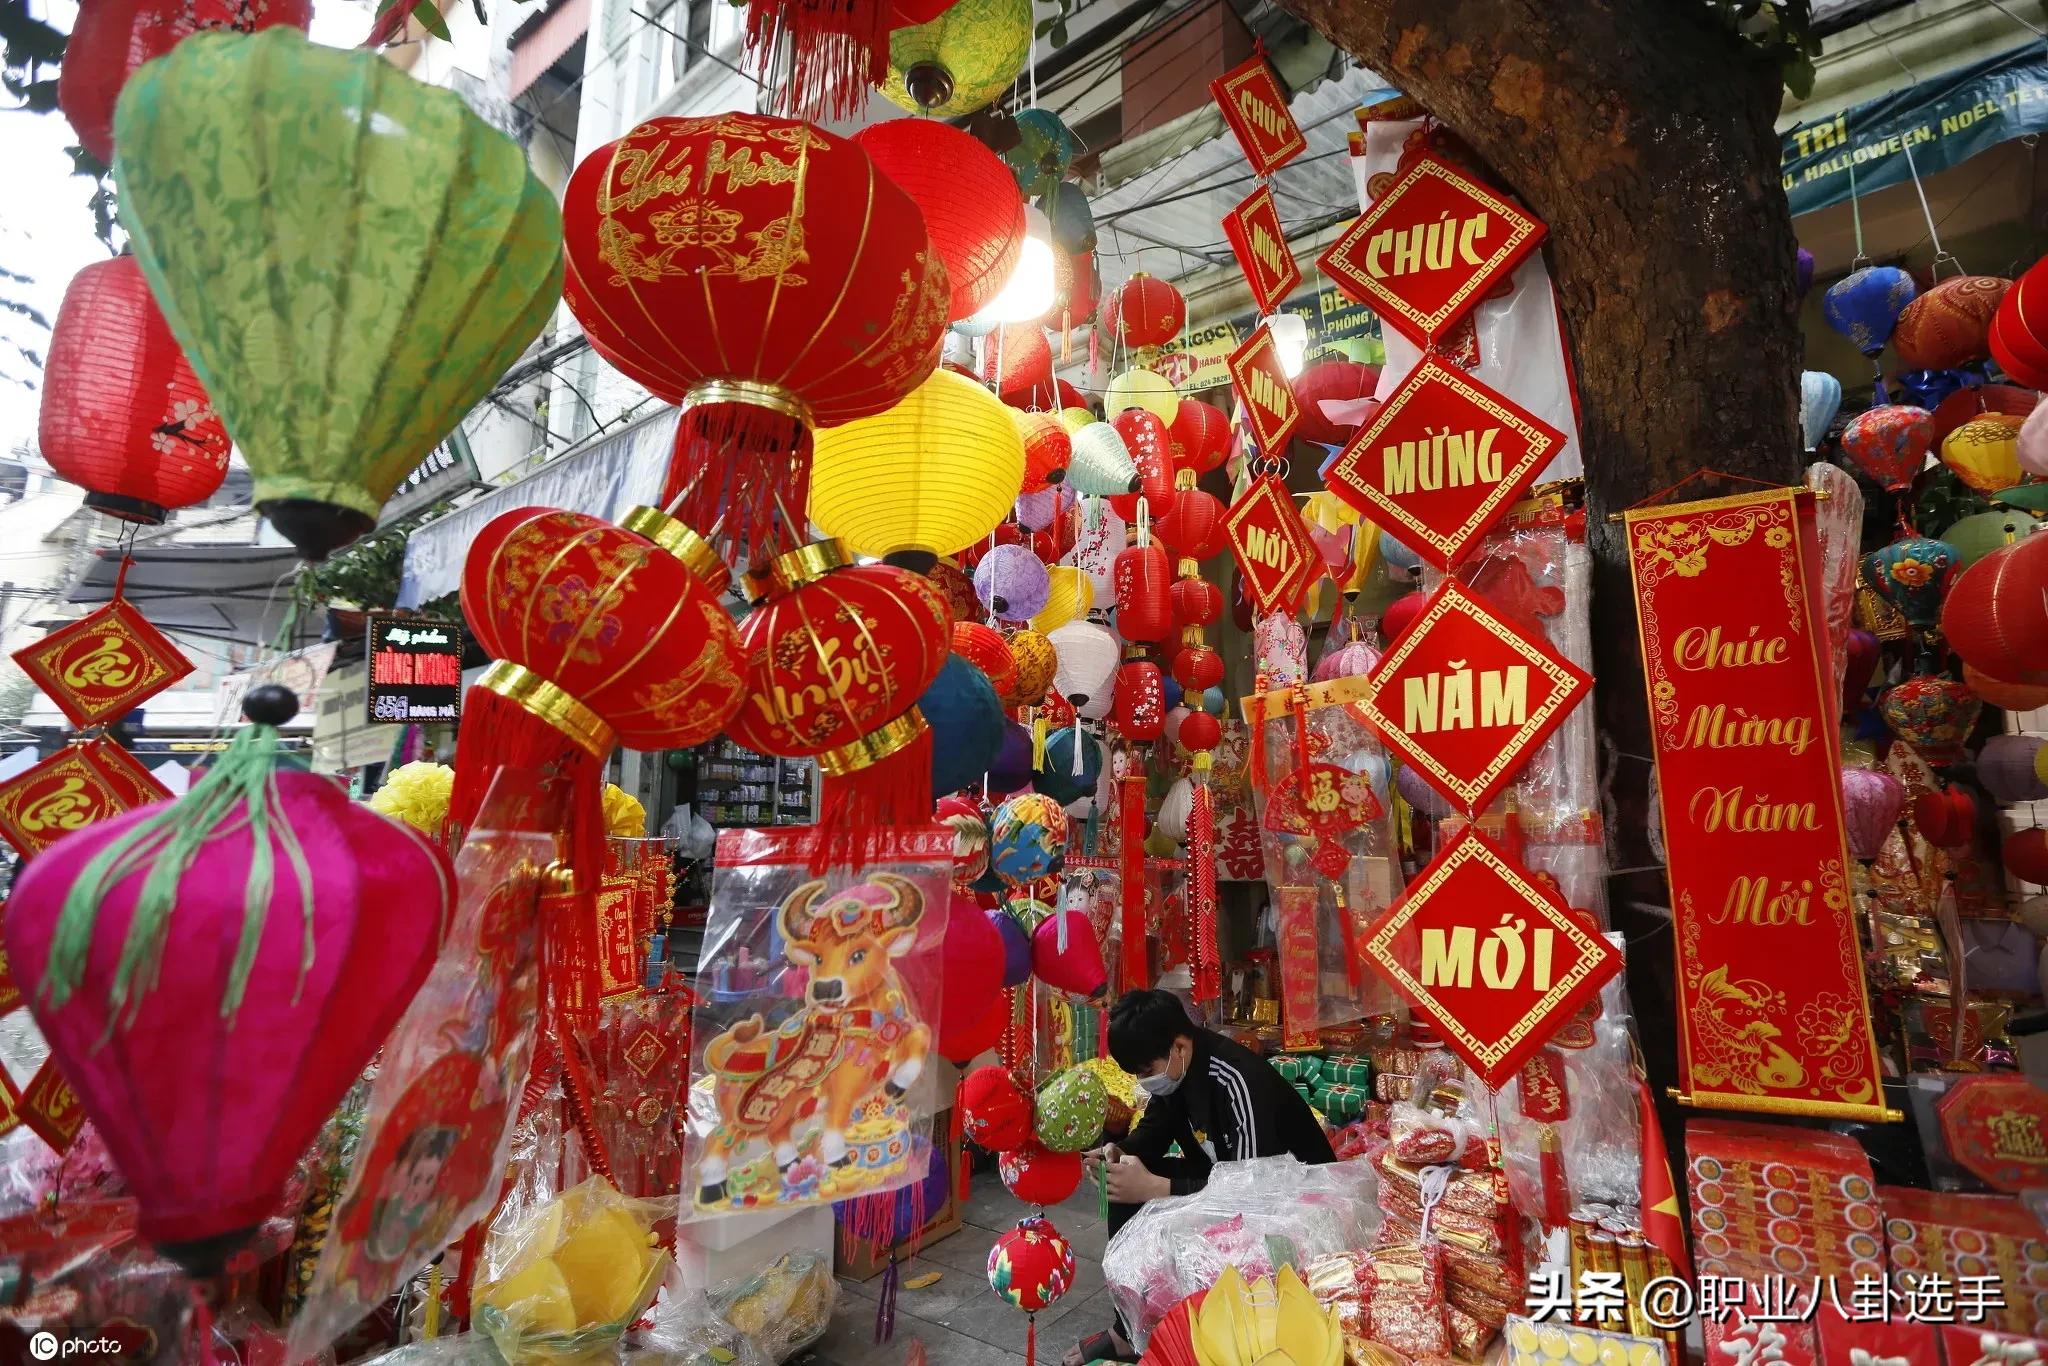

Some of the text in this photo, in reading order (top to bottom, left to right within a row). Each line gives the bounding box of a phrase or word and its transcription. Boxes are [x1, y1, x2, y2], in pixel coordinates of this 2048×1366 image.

[1240, 89, 1287, 145] CHÚC
[1793, 111, 1847, 158] TRÍ
[1253, 221, 1284, 281] MỪNG
[1365, 210, 1488, 279] CHÚC
[1250, 367, 1288, 422] NĂM
[1383, 425, 1502, 496] MỪNG
[1246, 524, 1289, 573] MỚI
[1673, 625, 1790, 672] Chúc
[1404, 658, 1528, 734] NĂM
[1669, 703, 1818, 756] Mừng
[1688, 785, 1823, 833] Năm
[1707, 875, 1817, 926] Mới
[1421, 912, 1554, 992] MỚI
